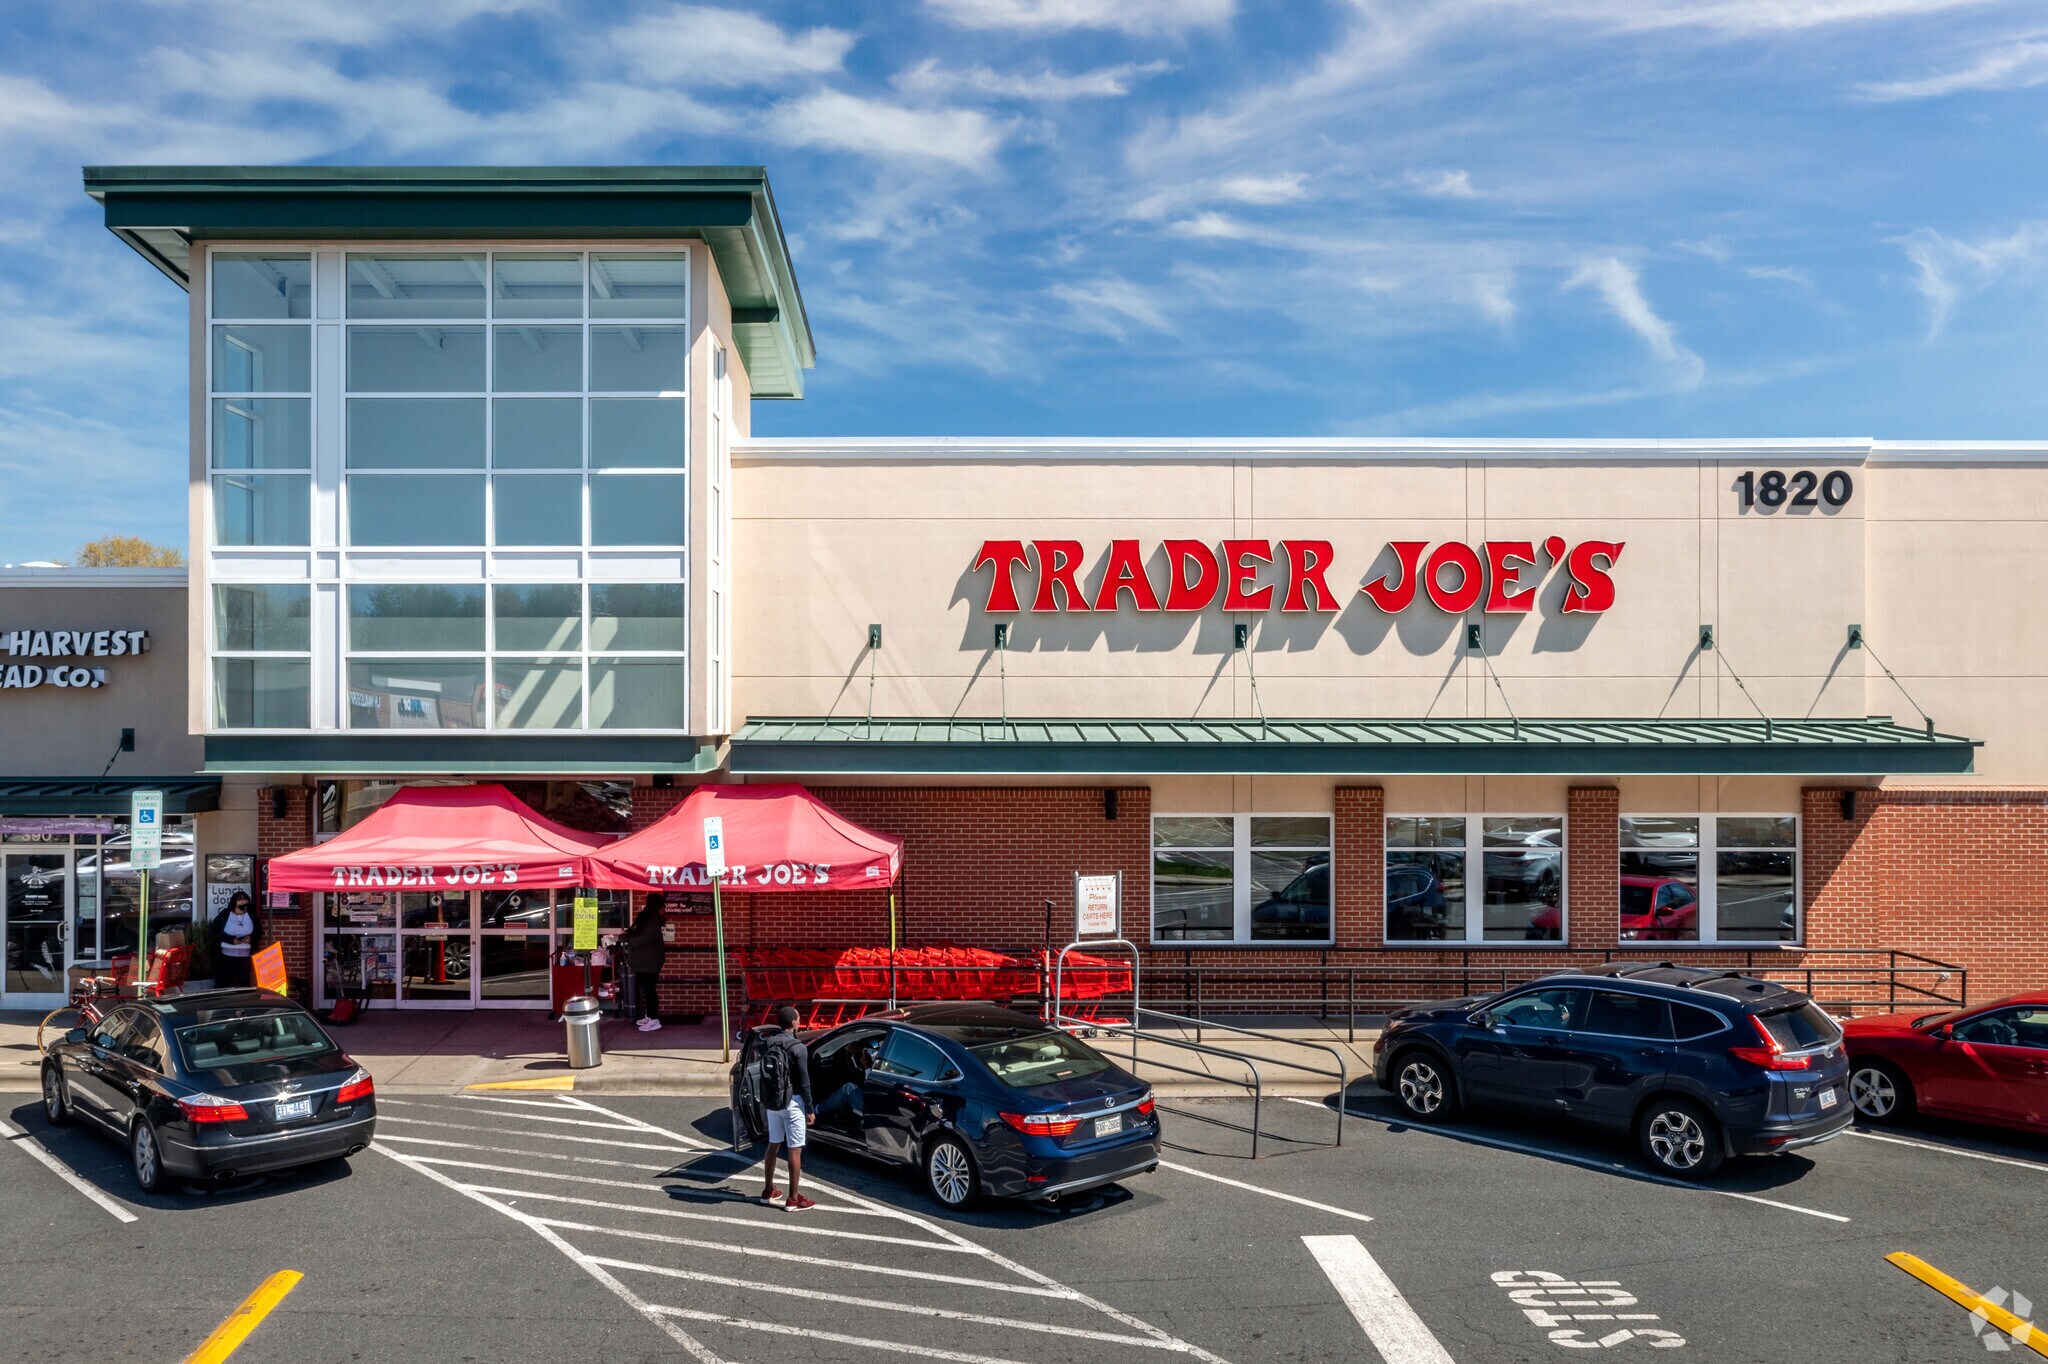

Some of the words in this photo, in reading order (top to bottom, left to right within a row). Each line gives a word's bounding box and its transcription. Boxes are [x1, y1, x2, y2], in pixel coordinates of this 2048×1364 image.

[1738, 470, 1853, 506] 1820
[973, 539, 1341, 613] TRADER
[1360, 536, 1626, 614] JOE'S
[9, 630, 145, 657] HARVEST
[0, 665, 43, 688] AD
[53, 665, 100, 688] CO.
[331, 865, 436, 886] TRADER
[444, 863, 520, 885] JOE'S
[756, 863, 831, 884] JOE'S
[1490, 1270, 1687, 1348] STOP
